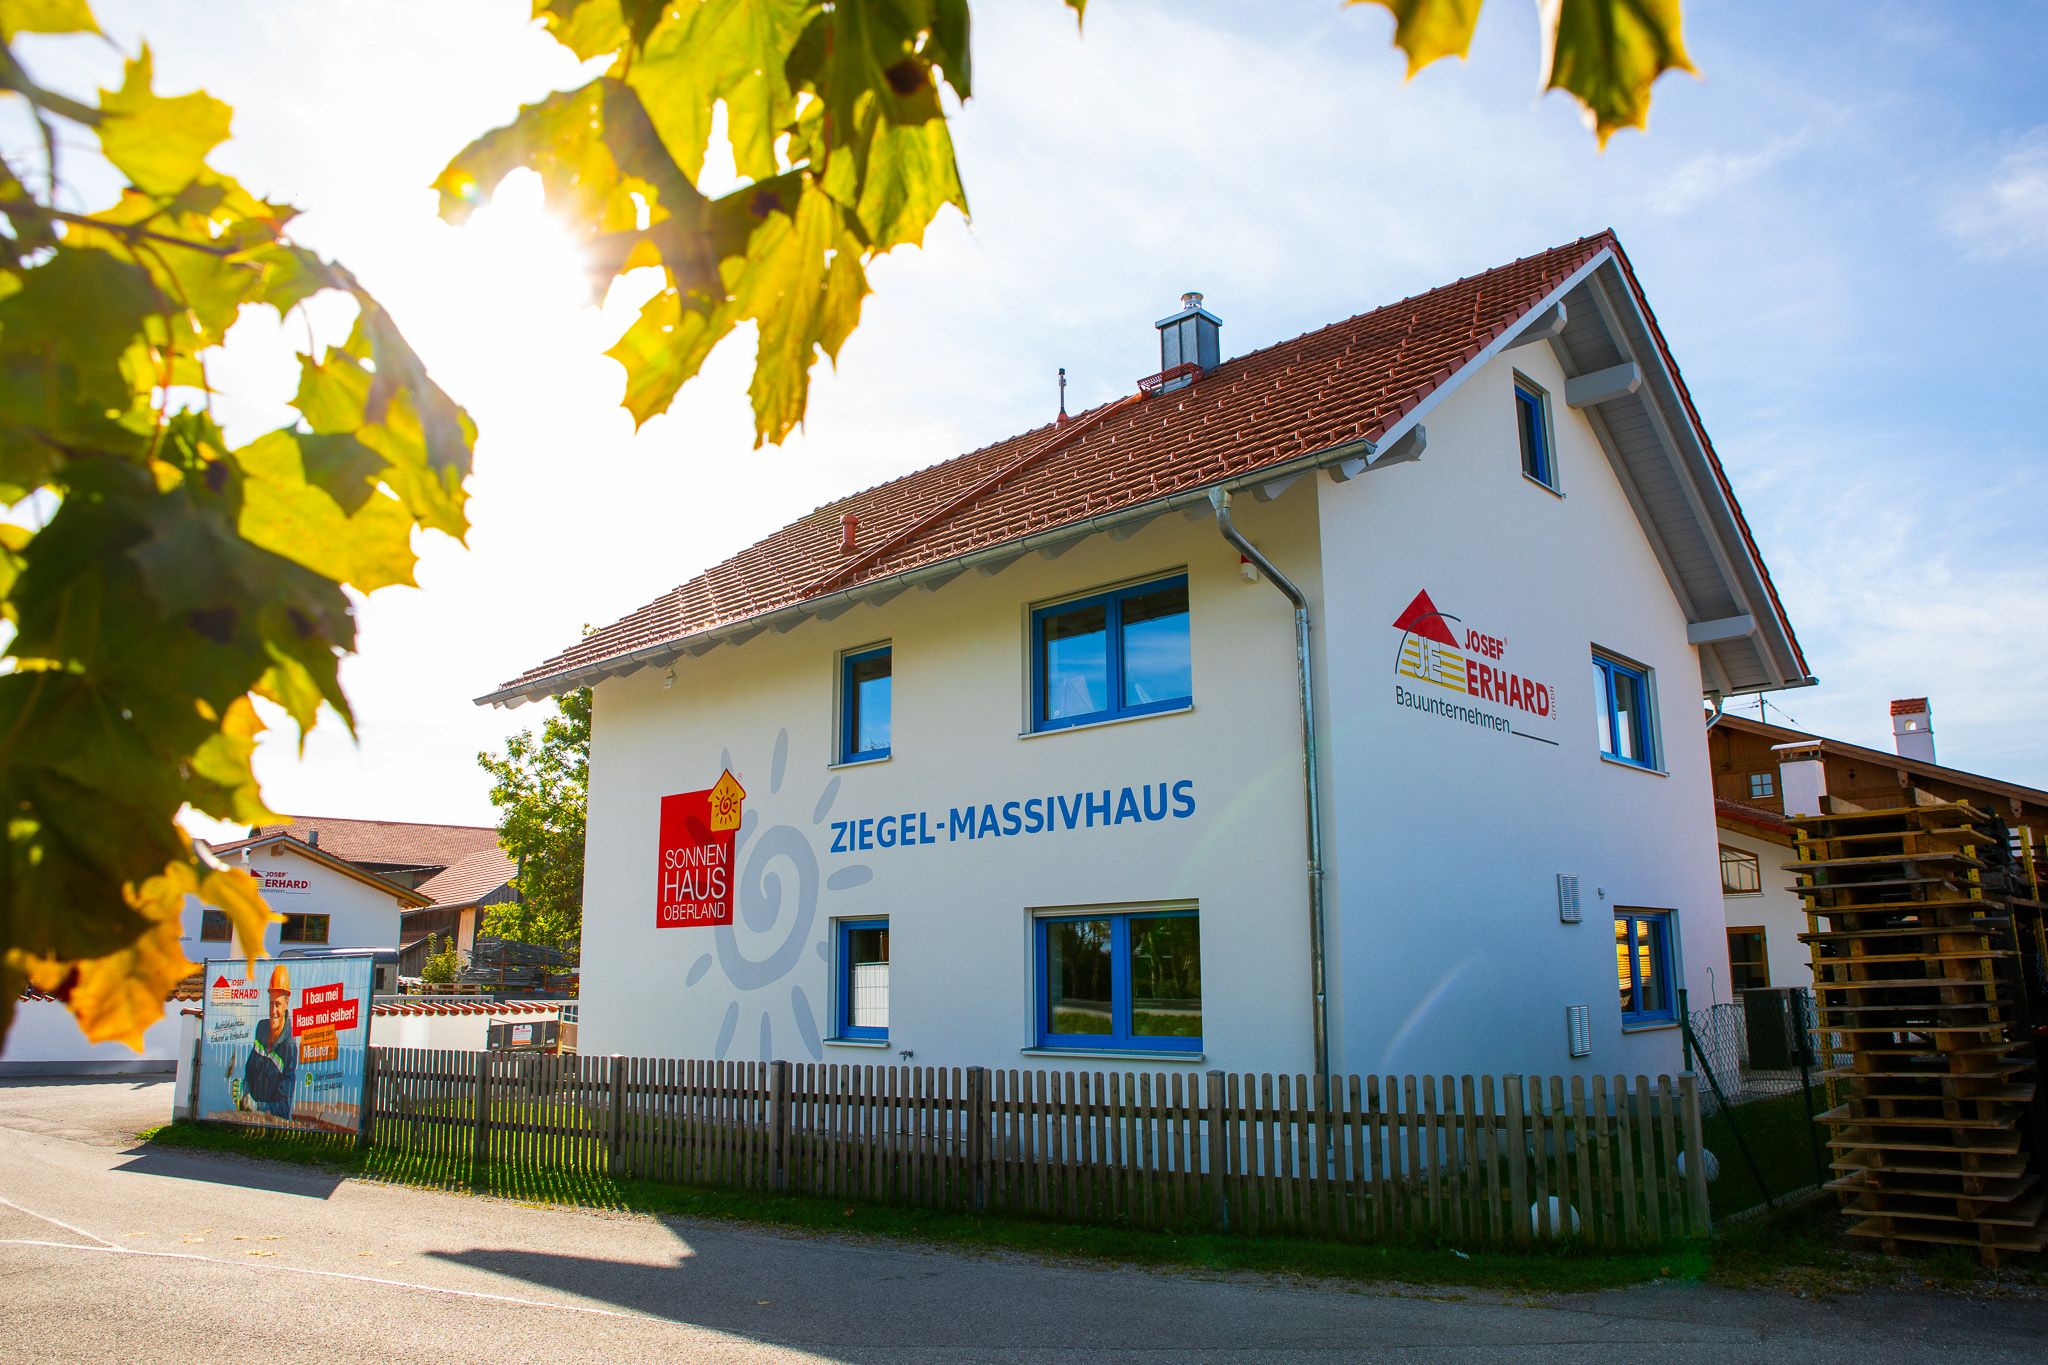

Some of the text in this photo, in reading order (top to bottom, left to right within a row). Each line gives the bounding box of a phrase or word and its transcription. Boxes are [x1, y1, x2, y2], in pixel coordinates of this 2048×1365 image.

[1464, 628, 1504, 660] JOSEF
[1465, 658, 1550, 717] ERHARD
[1396, 685, 1511, 733] Bauunternehmen
[830, 780, 1196, 853] ZIEGEL-MASSIVHAUS
[665, 842, 727, 870] SONNEN
[265, 879, 308, 889] ERHARD
[663, 867, 727, 903] HAUS
[663, 901, 726, 921] OBERLAND
[231, 989, 259, 999] ERHARD
[305, 987, 339, 1005] I bau mei
[296, 1006, 355, 1028] Haus moi selber!
[303, 1044, 330, 1058] Maurer
